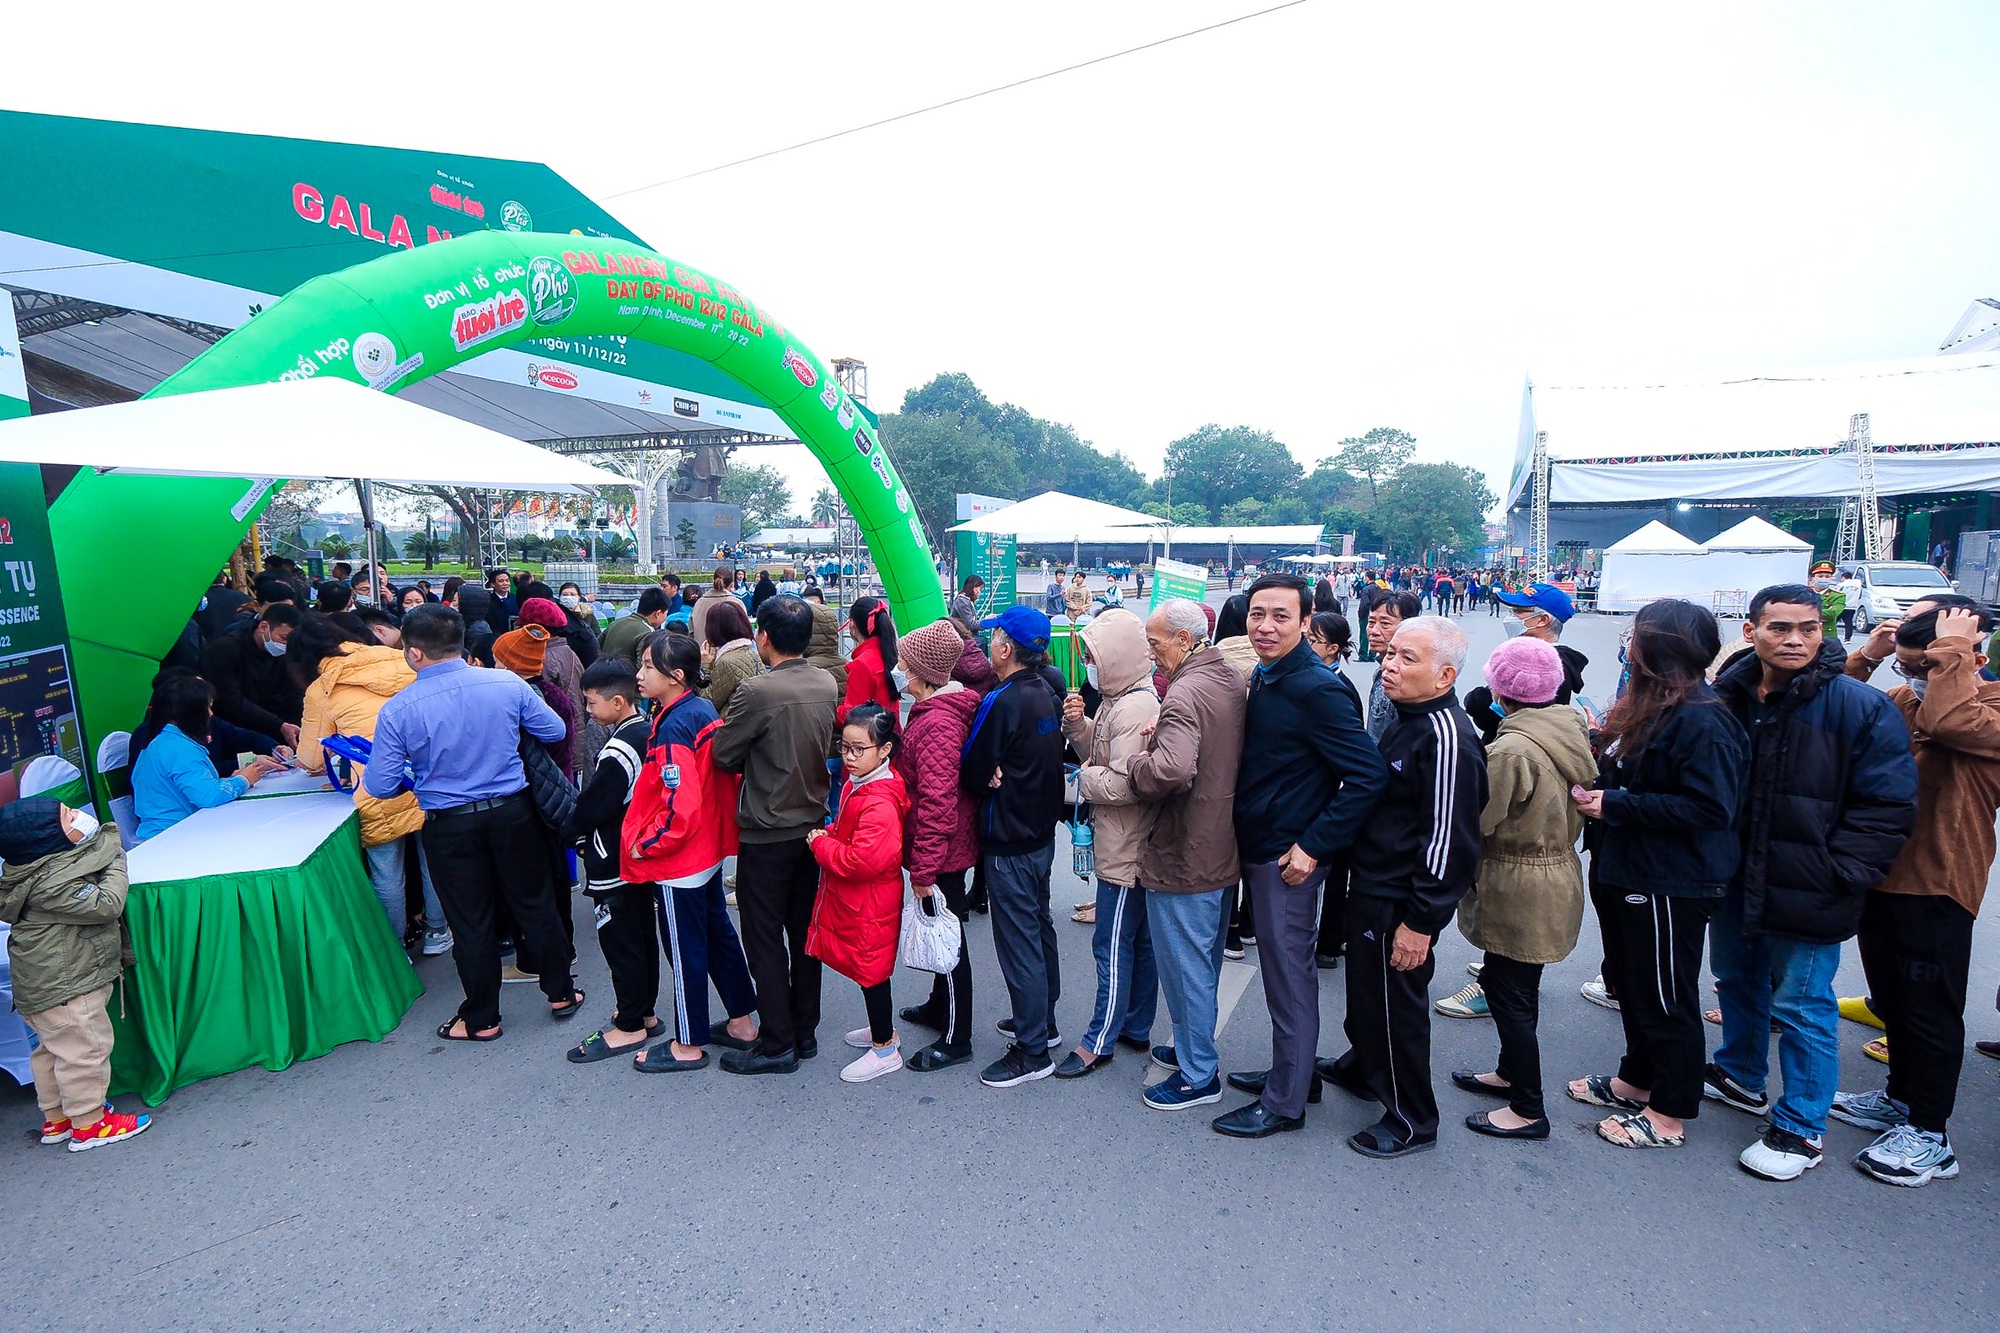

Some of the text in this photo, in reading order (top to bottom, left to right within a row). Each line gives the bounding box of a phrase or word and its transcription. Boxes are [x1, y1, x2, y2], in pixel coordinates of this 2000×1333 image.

[292, 182, 415, 250] GALA
[562, 252, 622, 274] GALA
[424, 261, 526, 309] Đơn vị tổ chức
[532, 272, 568, 312] Phở
[456, 304, 496, 344] tuổi
[497, 294, 525, 326] trẻ
[606, 279, 638, 299] DAY
[643, 281, 662, 300] OF
[699, 297, 727, 321] 12/12
[732, 309, 763, 338] GALA
[618, 305, 639, 315] Nam
[665, 309, 707, 330] December
[728, 329, 749, 347] 2022
[314, 337, 350, 365] hợp
[539, 337, 627, 366] ngày 11/12/22
[675, 400, 698, 412] CHIN-SU
[4, 560, 36, 597] TỤ
